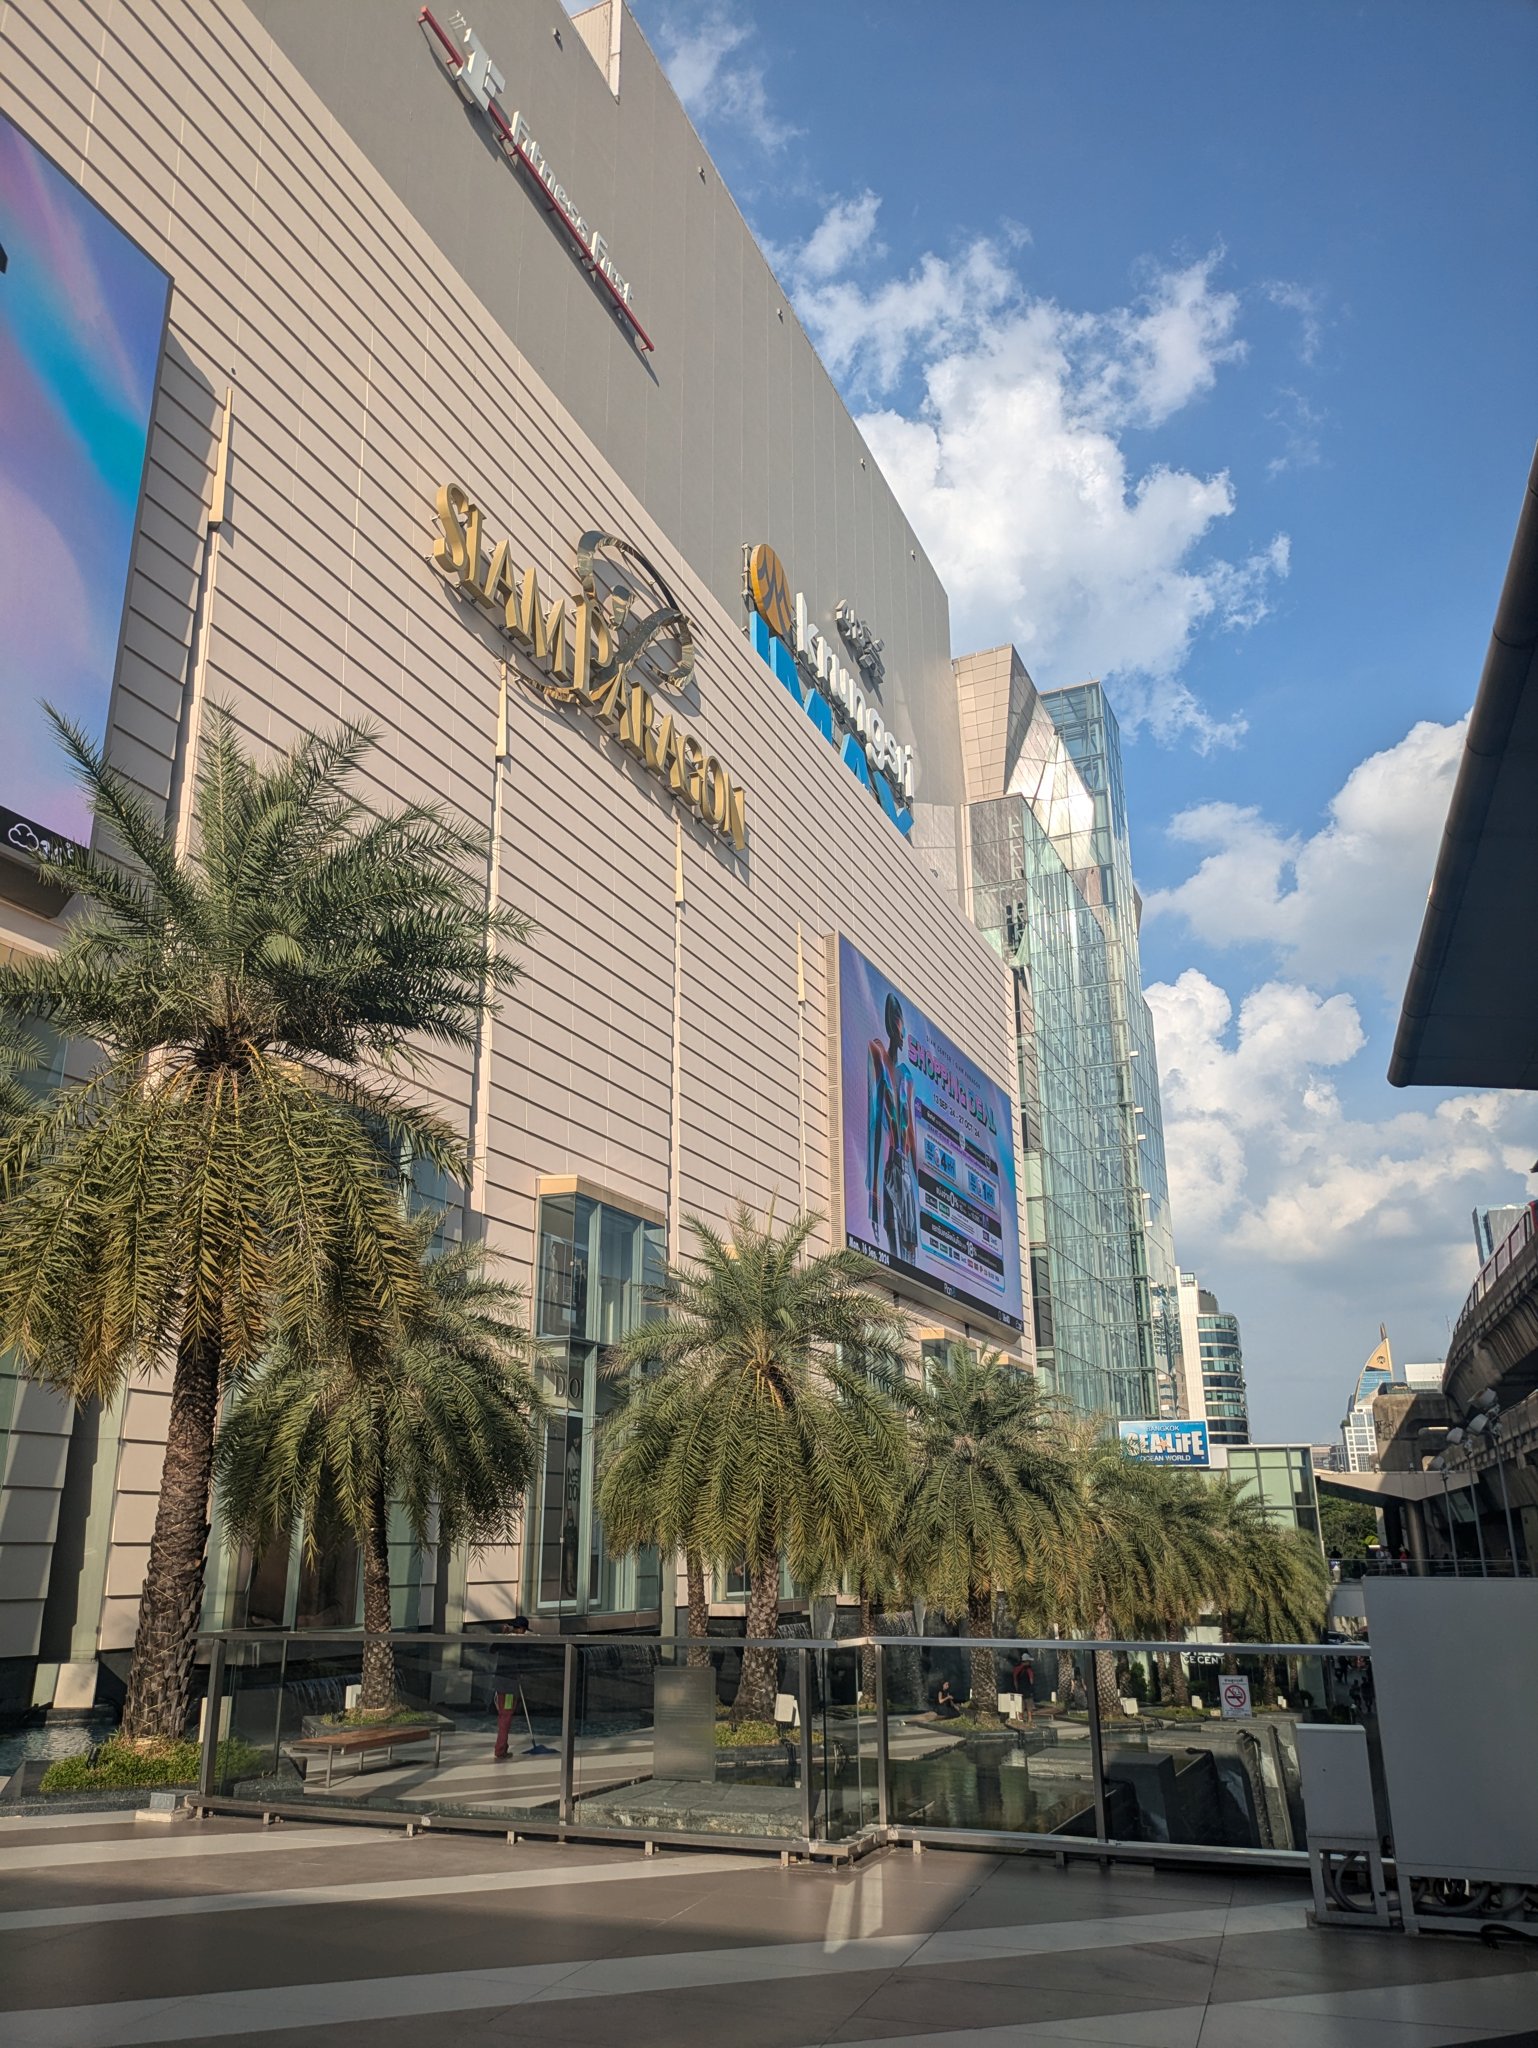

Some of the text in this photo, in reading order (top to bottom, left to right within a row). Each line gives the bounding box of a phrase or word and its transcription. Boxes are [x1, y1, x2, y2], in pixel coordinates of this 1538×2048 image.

[509, 111, 634, 305] Fitness First
[434, 483, 745, 850] SIAM PARAGON
[796, 592, 914, 801] krungsri
[908, 1034, 967, 1110] SHOPPING
[968, 1088, 997, 1136] DEAL
[1140, 1454, 1191, 1462] OCEAN WORLD
